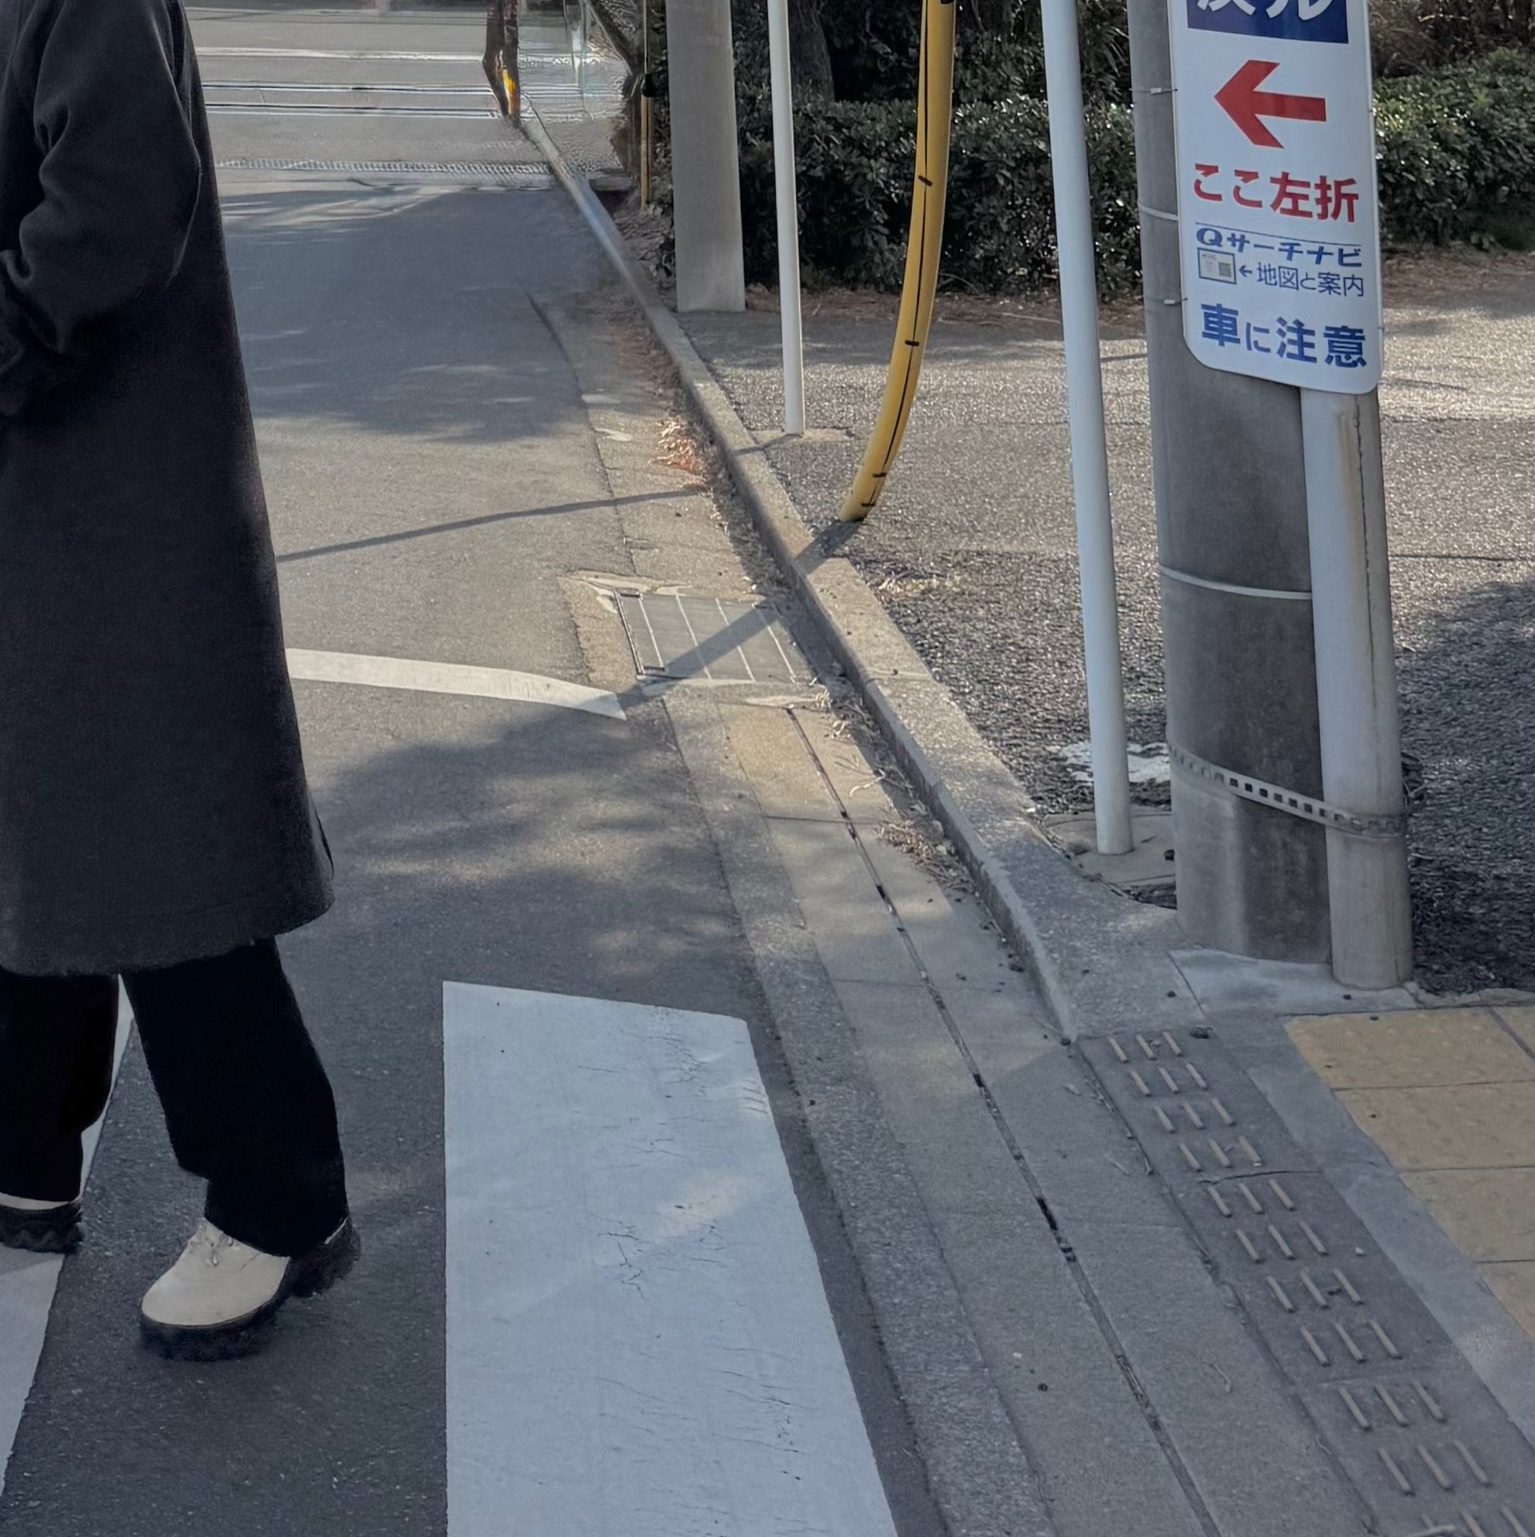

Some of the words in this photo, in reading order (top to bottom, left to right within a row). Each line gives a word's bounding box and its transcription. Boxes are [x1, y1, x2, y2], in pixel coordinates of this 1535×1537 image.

[1193, 163, 1359, 223] ここ左折
[1196, 227, 1362, 268] Qサーチナビ
[1256, 262, 1365, 297] 地図と案内
[1200, 303, 1367, 369] 車に注意
